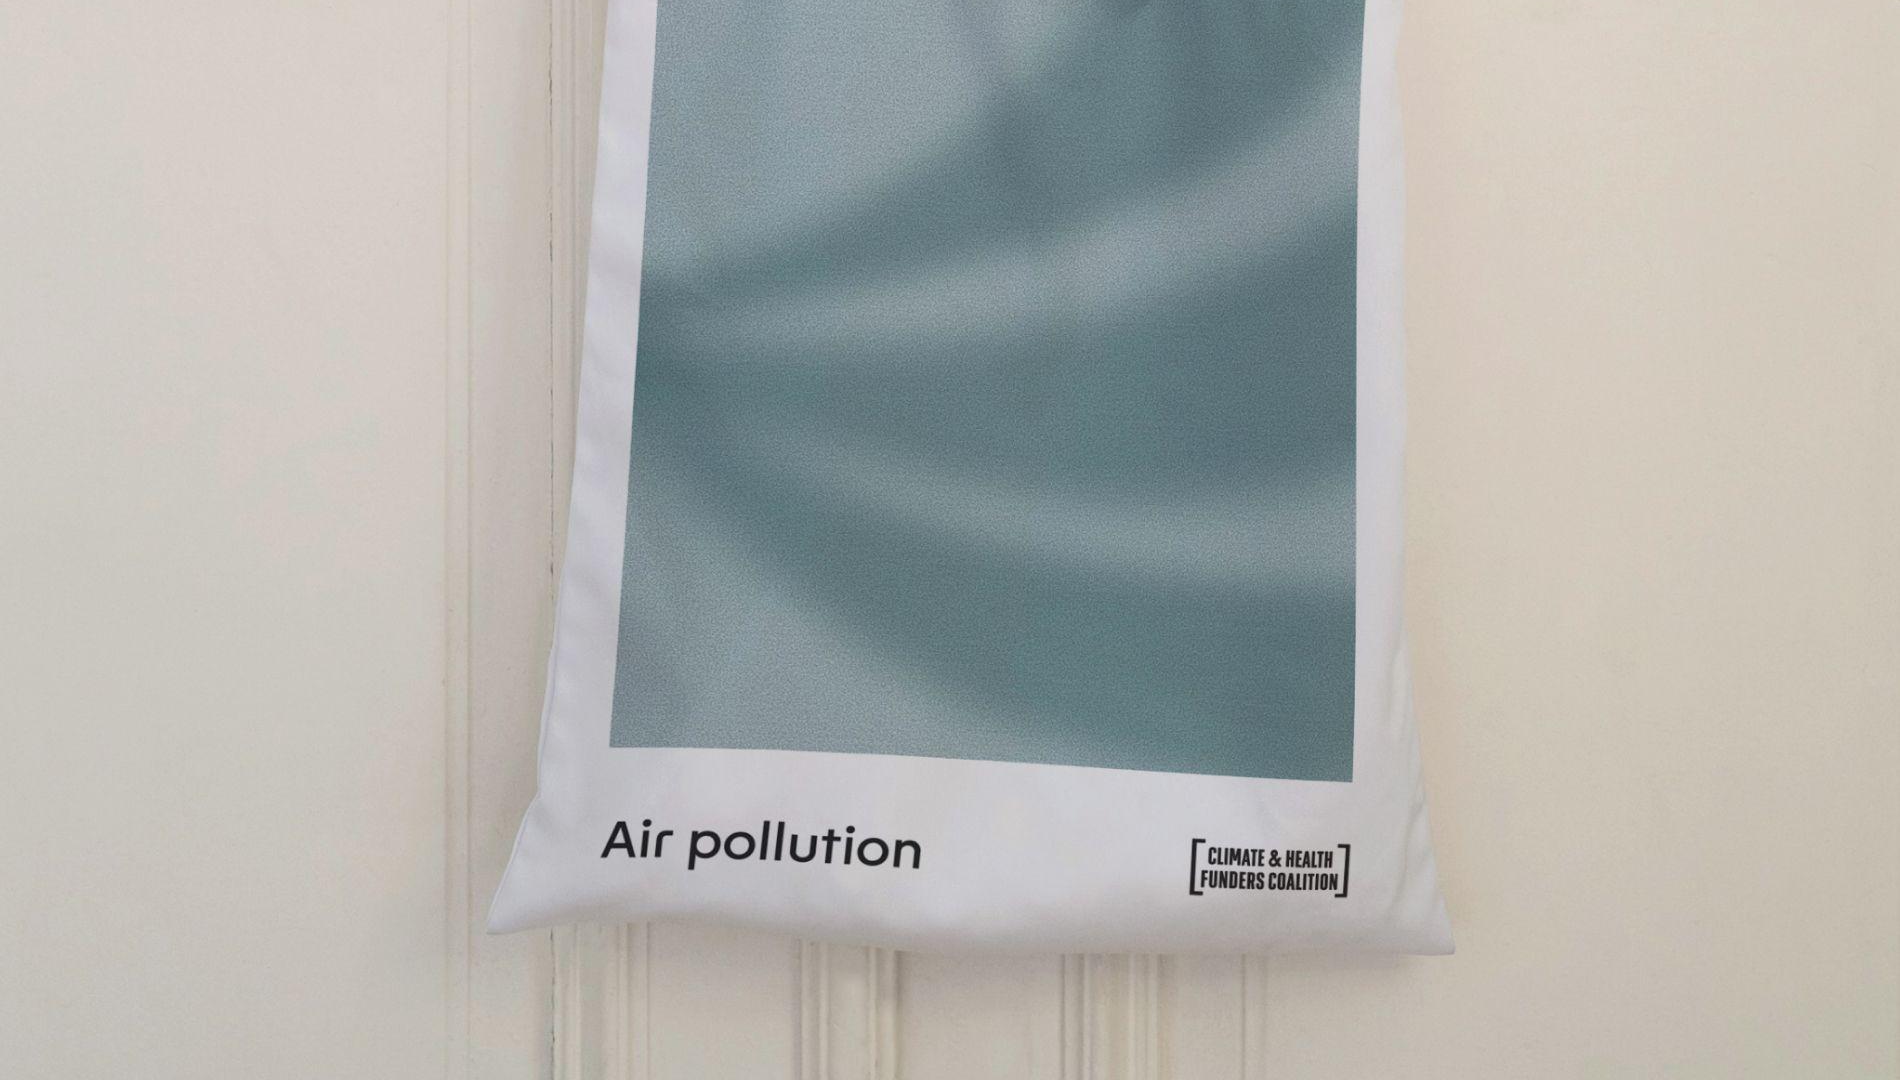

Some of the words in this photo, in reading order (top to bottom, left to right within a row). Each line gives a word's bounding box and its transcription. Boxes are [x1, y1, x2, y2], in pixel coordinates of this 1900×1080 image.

[600, 818, 674, 859] Air
[687, 819, 922, 871] pollution
[1207, 846, 1266, 867] CLIMATE
[1268, 849, 1282, 868] &
[1285, 849, 1334, 869] HEALTH
[1200, 869, 1265, 891] FUNDERS
[1267, 871, 1339, 891] COALITION
